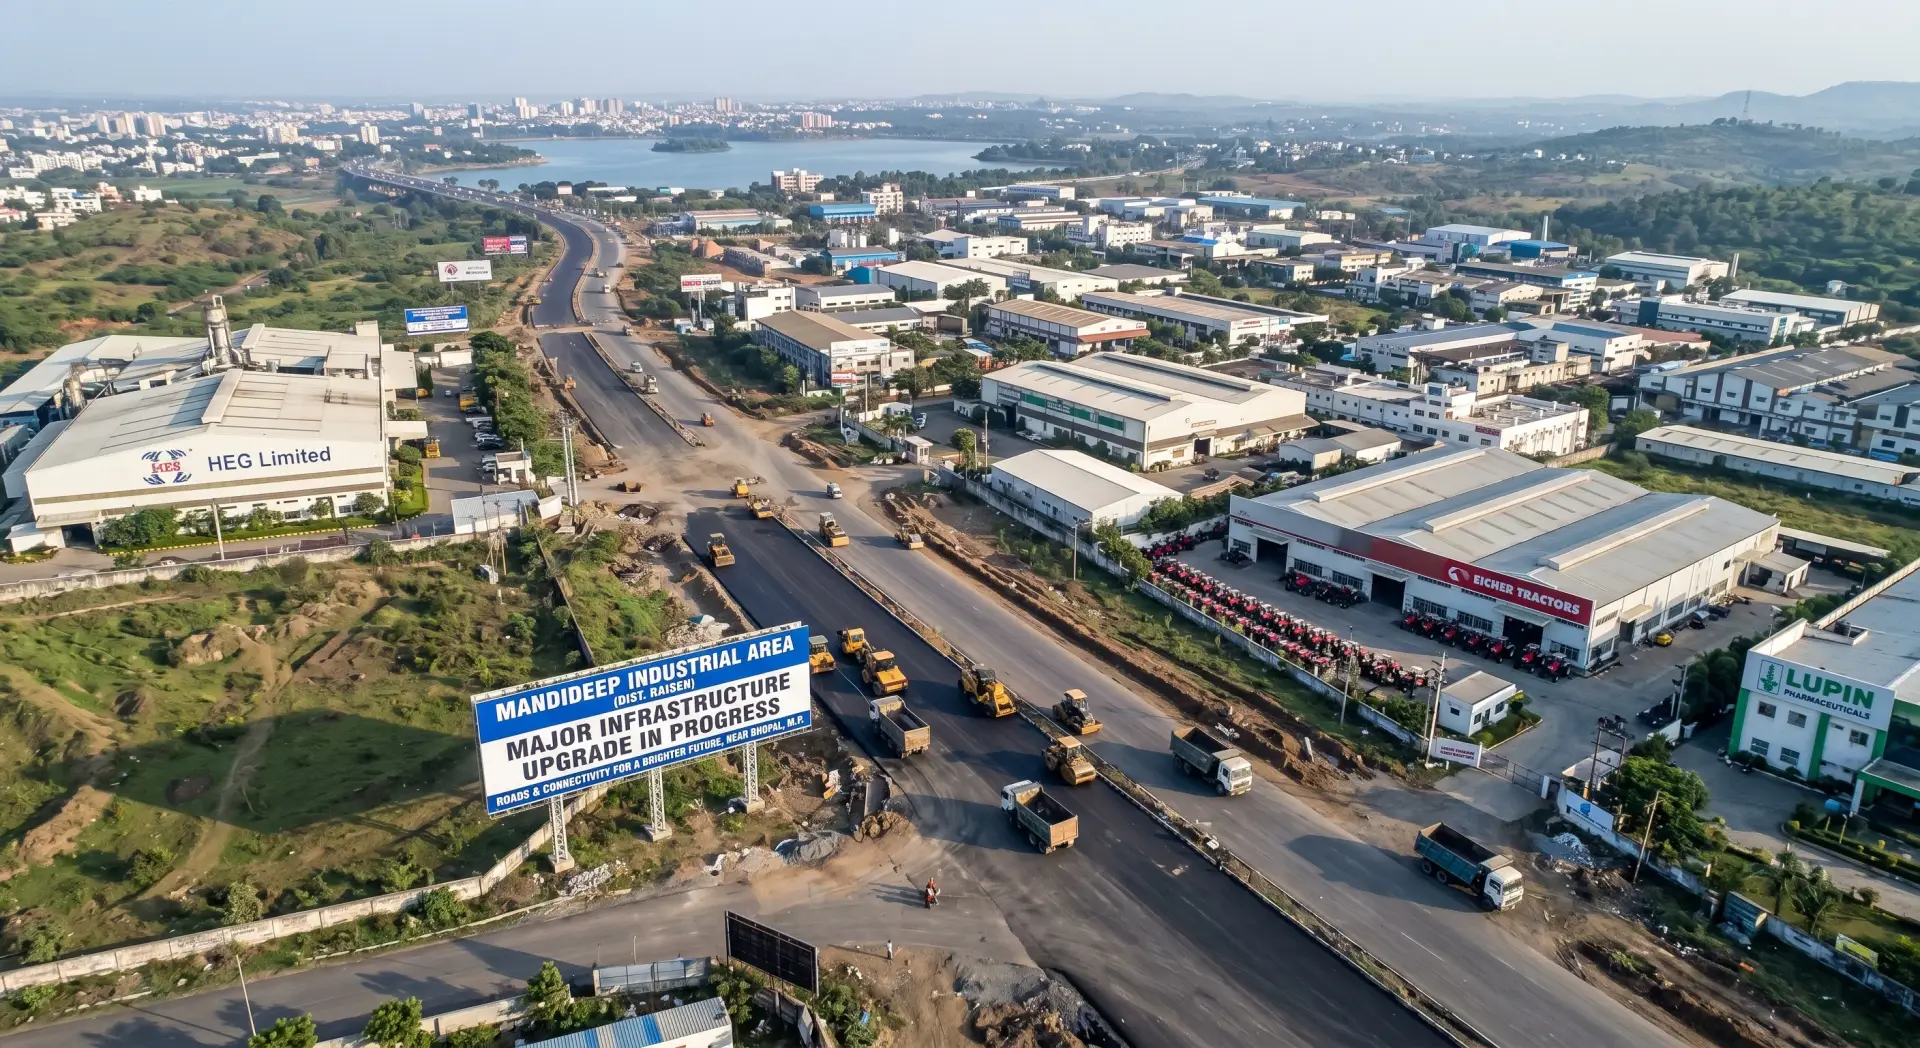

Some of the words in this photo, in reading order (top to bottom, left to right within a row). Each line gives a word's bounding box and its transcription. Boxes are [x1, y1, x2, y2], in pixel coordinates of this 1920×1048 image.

[208, 454, 252, 472] HEG
[259, 446, 331, 467] Limited
[1473, 574, 1514, 594] EICHER
[1517, 587, 1580, 615] TRACTORS
[496, 676, 621, 722] MANDIDEEP
[628, 648, 741, 690] INDUSTRIAL
[747, 634, 794, 662] AREA
[613, 690, 647, 709] (DIST.
[650, 678, 695, 698] RAISEN)
[1786, 668, 1875, 709] LUPIN
[506, 723, 592, 762] MAJOR
[600, 672, 791, 737] INFRASTRUCTURE
[1784, 688, 1870, 720] PHARMACEUTICALS
[522, 735, 632, 781] UPGRADE
[640, 727, 662, 749] IN
[670, 697, 780, 742] PROGRESS
[496, 789, 530, 807] ROADS
[532, 787, 541, 797] &
[543, 767, 611, 794] CONNECTIVITY
[613, 762, 632, 775] FOR
[634, 759, 641, 769] A
[642, 747, 686, 767] BRIGHTER
[688, 738, 725, 755] FUTURE,
[726, 731, 749, 744] NEAR
[750, 721, 785, 738] BHOPAL,
[787, 715, 805, 727] M.P.
